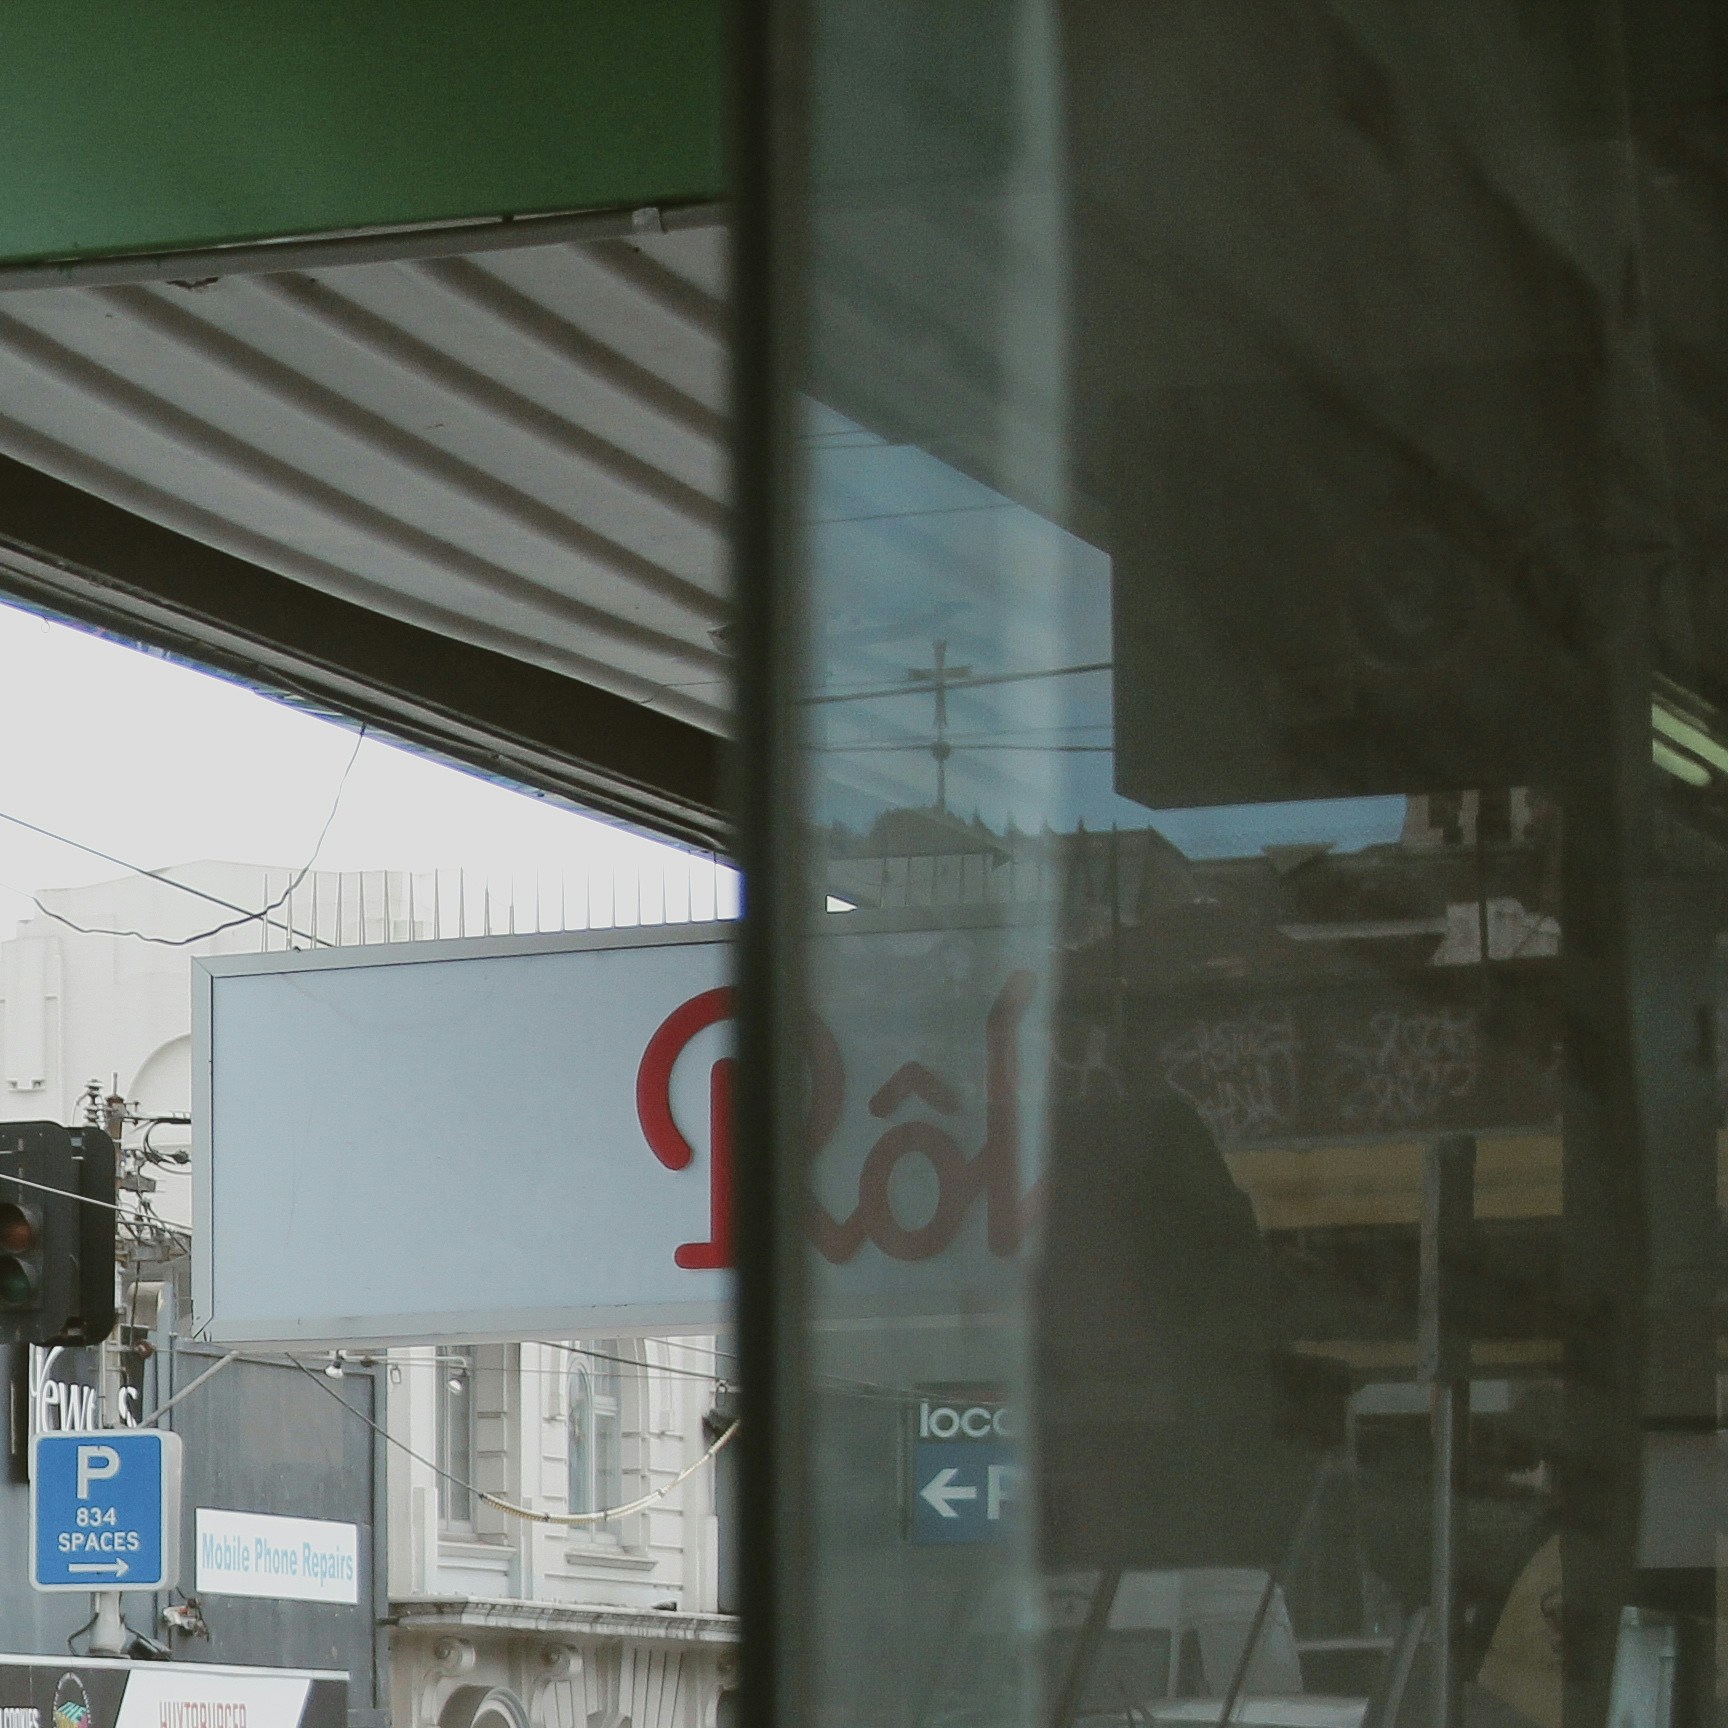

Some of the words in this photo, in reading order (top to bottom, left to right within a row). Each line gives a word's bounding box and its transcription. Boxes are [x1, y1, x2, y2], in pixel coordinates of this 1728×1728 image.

[76, 1445, 121, 1500] P
[75, 1506, 118, 1526] 834
[57, 1531, 140, 1552] SPACES
[202, 1532, 250, 1572] Mobile
[254, 1537, 298, 1576] Phone
[302, 1542, 354, 1587] Repairs
